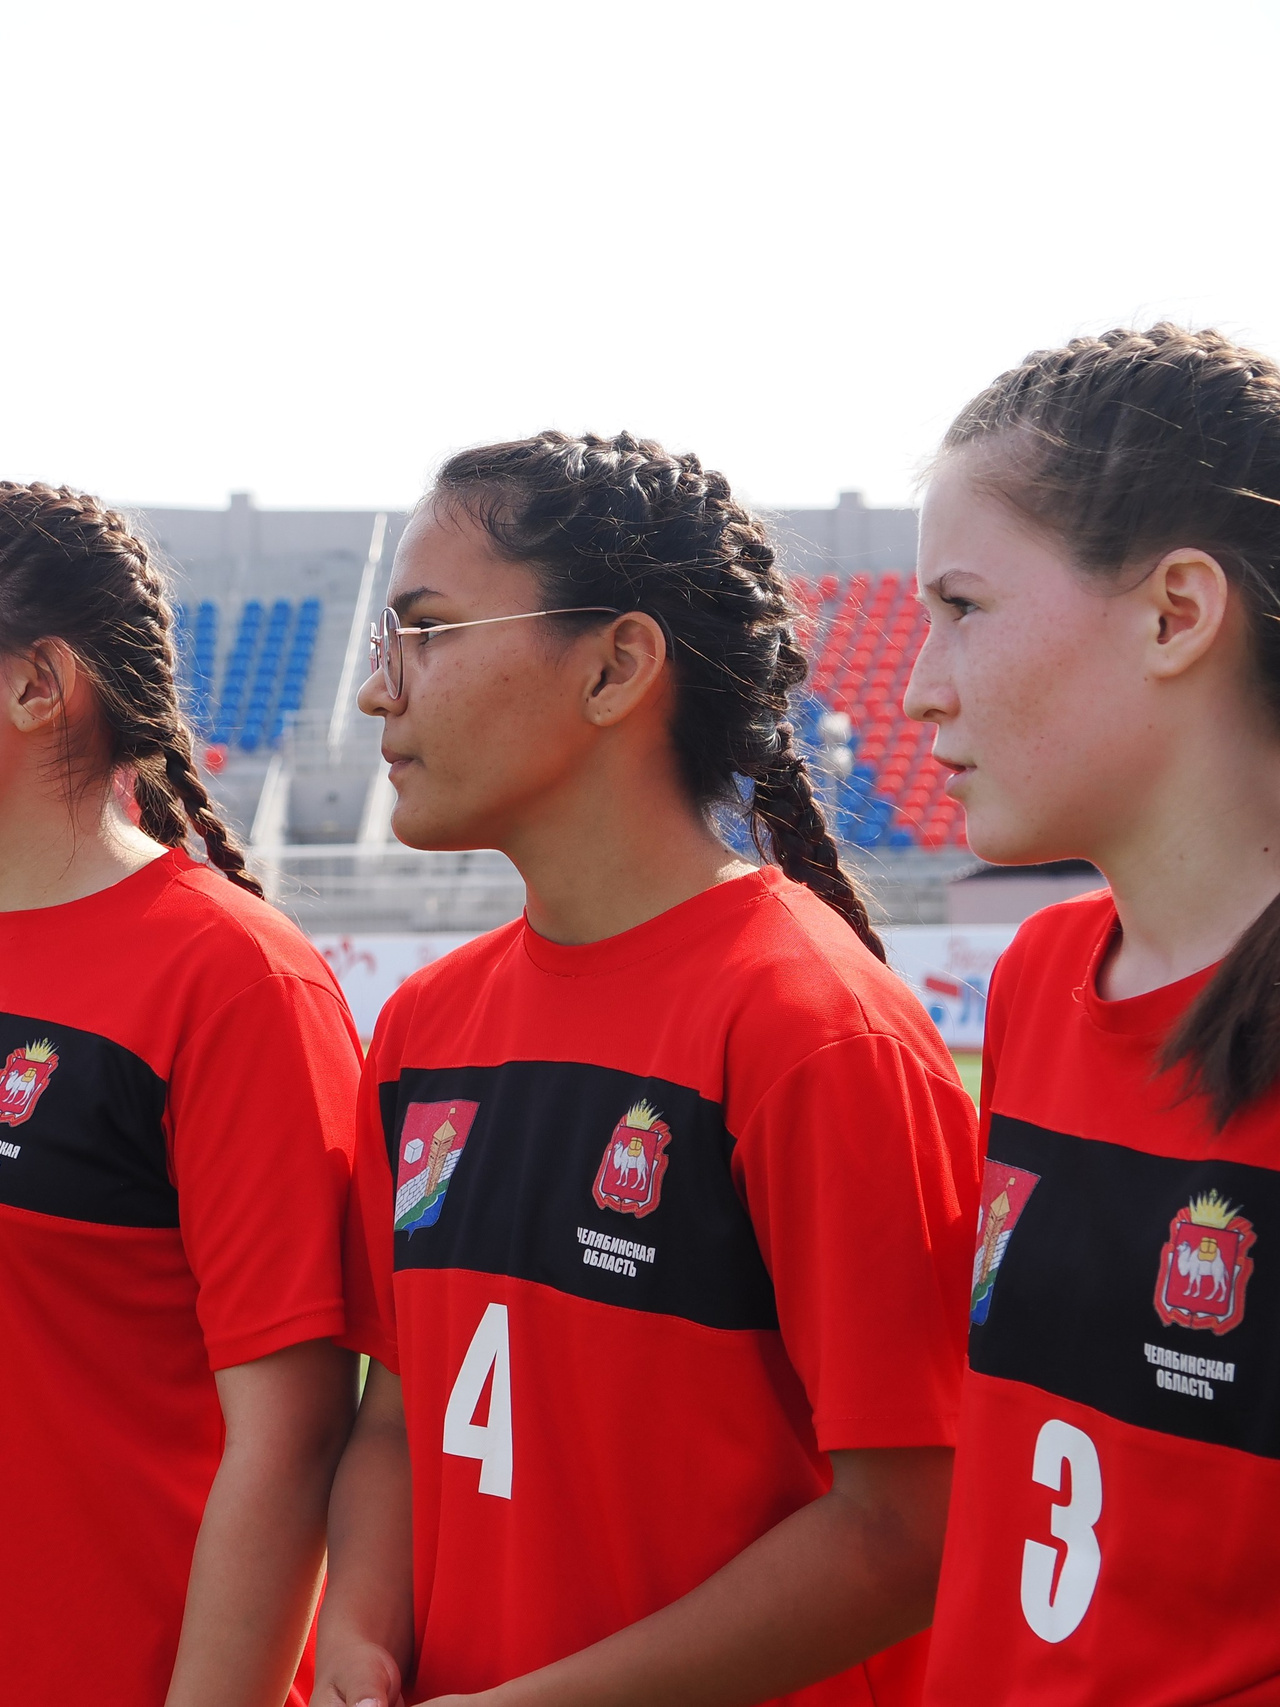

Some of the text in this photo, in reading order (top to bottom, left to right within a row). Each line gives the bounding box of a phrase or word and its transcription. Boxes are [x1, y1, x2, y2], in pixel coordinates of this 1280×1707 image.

[576, 1226, 656, 1264] ЧЕЛЯБИНСКАЯ
[582, 1248, 637, 1278] ОБЛАСТЬ
[1144, 1342, 1236, 1382] ЧЕЛЯБИНСКАЯ
[443, 1302, 513, 1500] 4
[1156, 1368, 1214, 1401] ОБЛАСТЬ
[1020, 1419, 1103, 1644] 3
